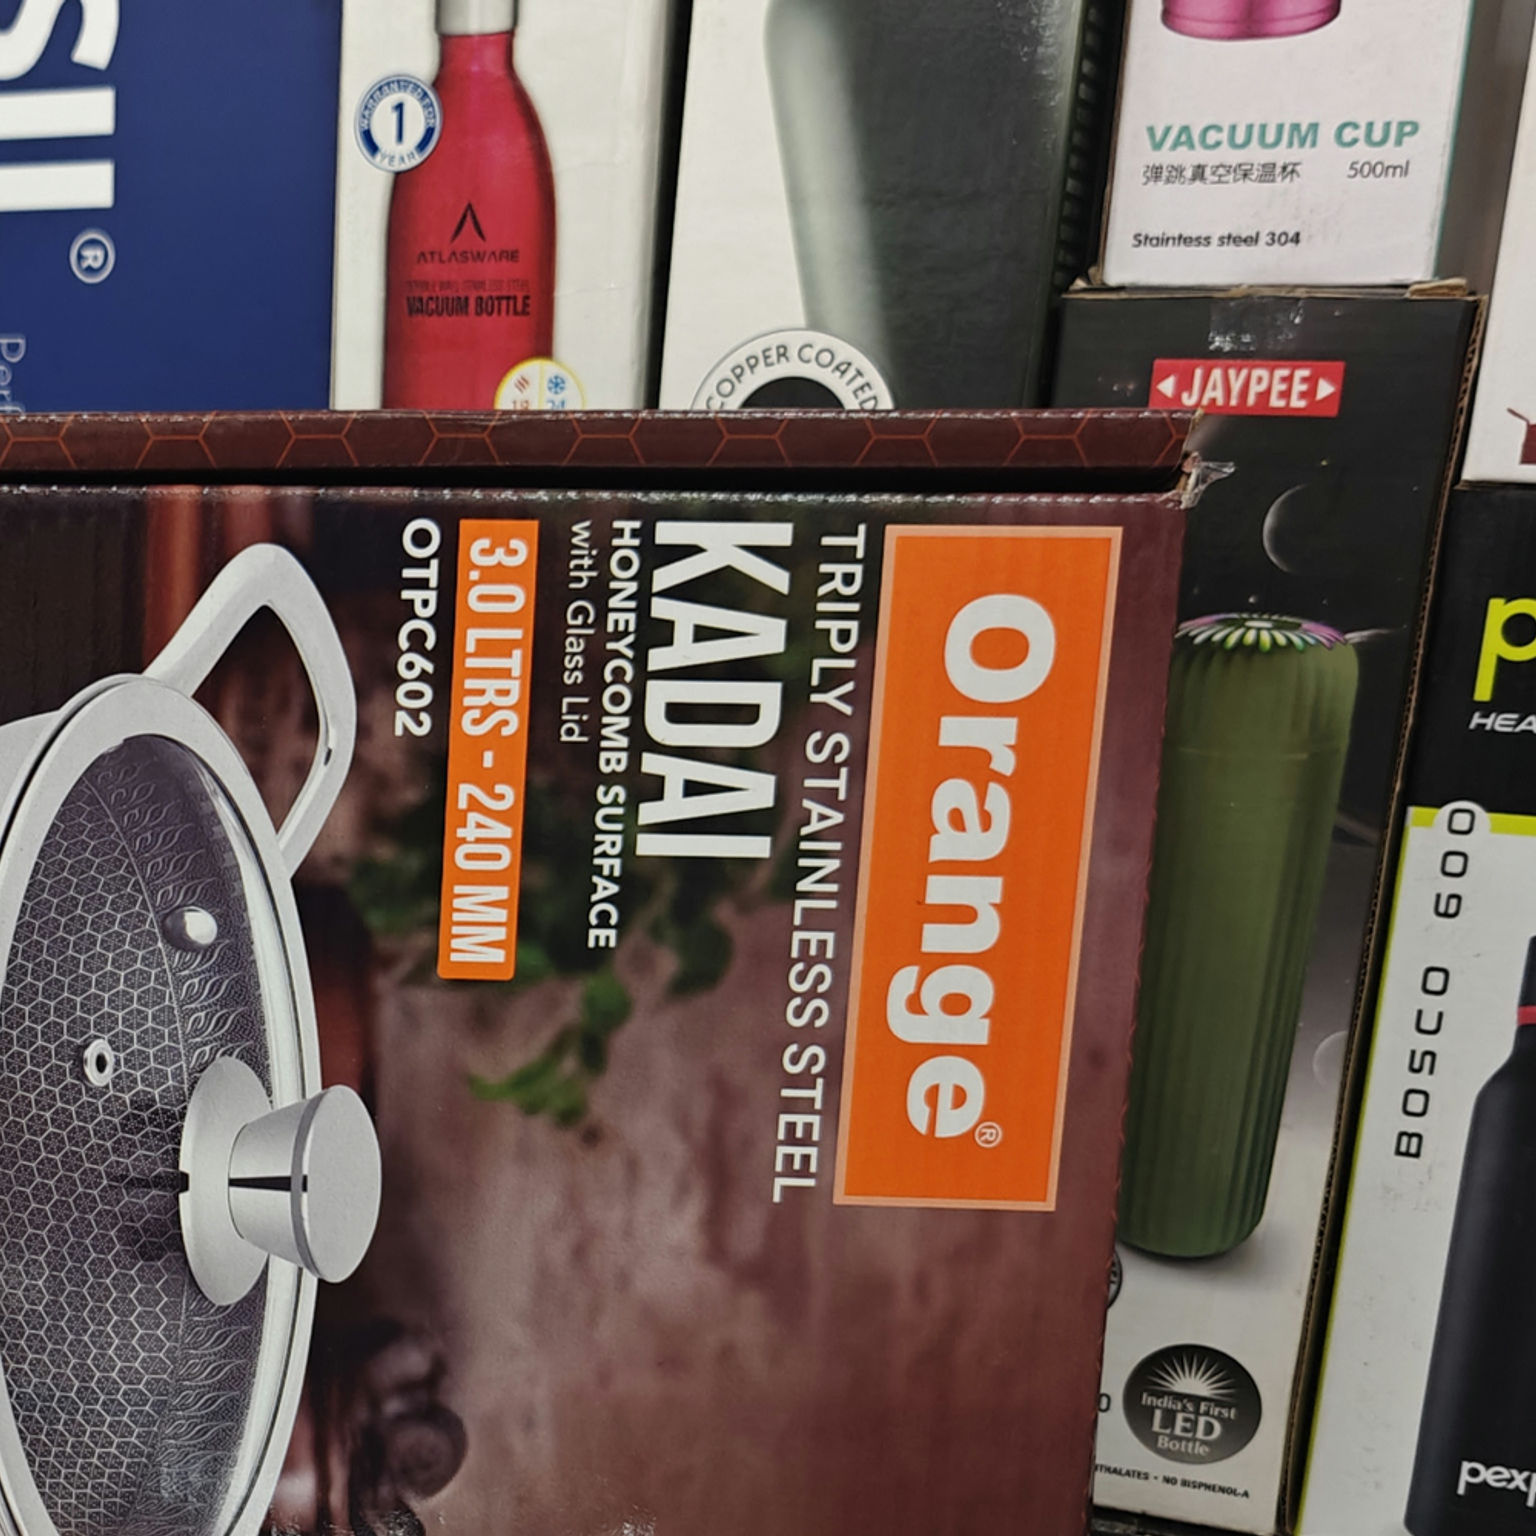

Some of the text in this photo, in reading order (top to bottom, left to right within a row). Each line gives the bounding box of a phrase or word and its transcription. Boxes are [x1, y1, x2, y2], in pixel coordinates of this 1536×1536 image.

[392, 101, 404, 144] 1
[1145, 119, 1420, 152] VACUUM CUP
[378, 149, 417, 167] YEAR
[1346, 159, 1410, 180] 500ml
[417, 249, 520, 264] ATLASWARE
[1131, 231, 1302, 249] Stainless steel 304
[406, 294, 531, 317] VACUUM BOTTLE
[705, 344, 879, 409] COPPER COATED
[1180, 367, 1312, 409] JAYPEE
[465, 537, 530, 614] 3.0
[393, 516, 443, 738] OTPC602
[559, 518, 600, 744] with Glass Lid
[460, 626, 524, 738] LTRS
[634, 520, 795, 859] KADAI
[586, 519, 643, 950] HONEYCOMB SURFACE
[453, 783, 516, 872] 240
[771, 522, 867, 1205] TRIPLY STAINLESS STEEL
[885, 593, 1056, 1140] Orange
[448, 885, 511, 964] MM
[1394, 807, 1477, 1159] BOSCO 600
[1141, 1391, 1238, 1420] India's First
[1151, 1408, 1222, 1442] LED
[1156, 1435, 1212, 1456] Bottle
[1162, 1475, 1179, 1487] NO
[1180, 1479, 1250, 1499] BISPHENOL-A
